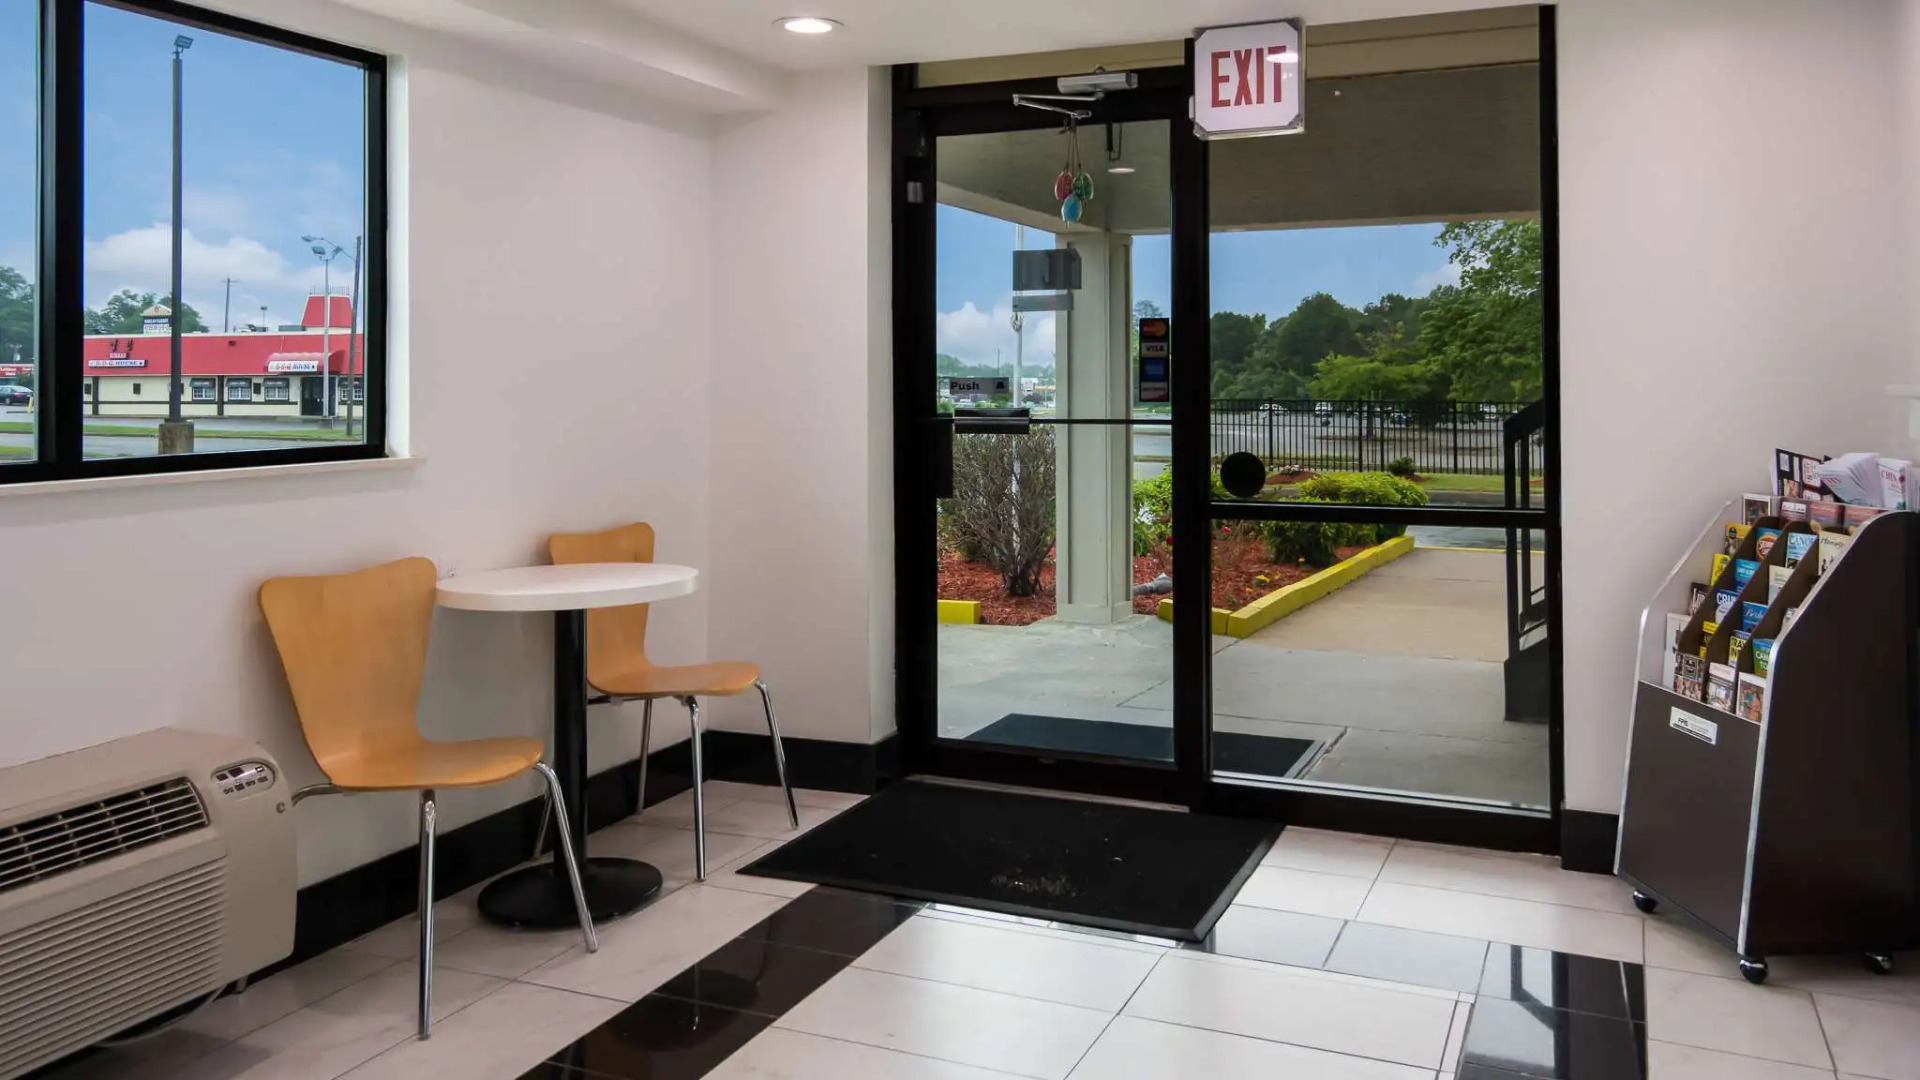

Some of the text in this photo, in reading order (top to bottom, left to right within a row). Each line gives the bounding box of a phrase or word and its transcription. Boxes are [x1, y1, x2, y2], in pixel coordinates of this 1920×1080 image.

[1211, 45, 1287, 108] EXIT
[1145, 344, 1165, 352] VISA
[950, 381, 980, 391] Push
